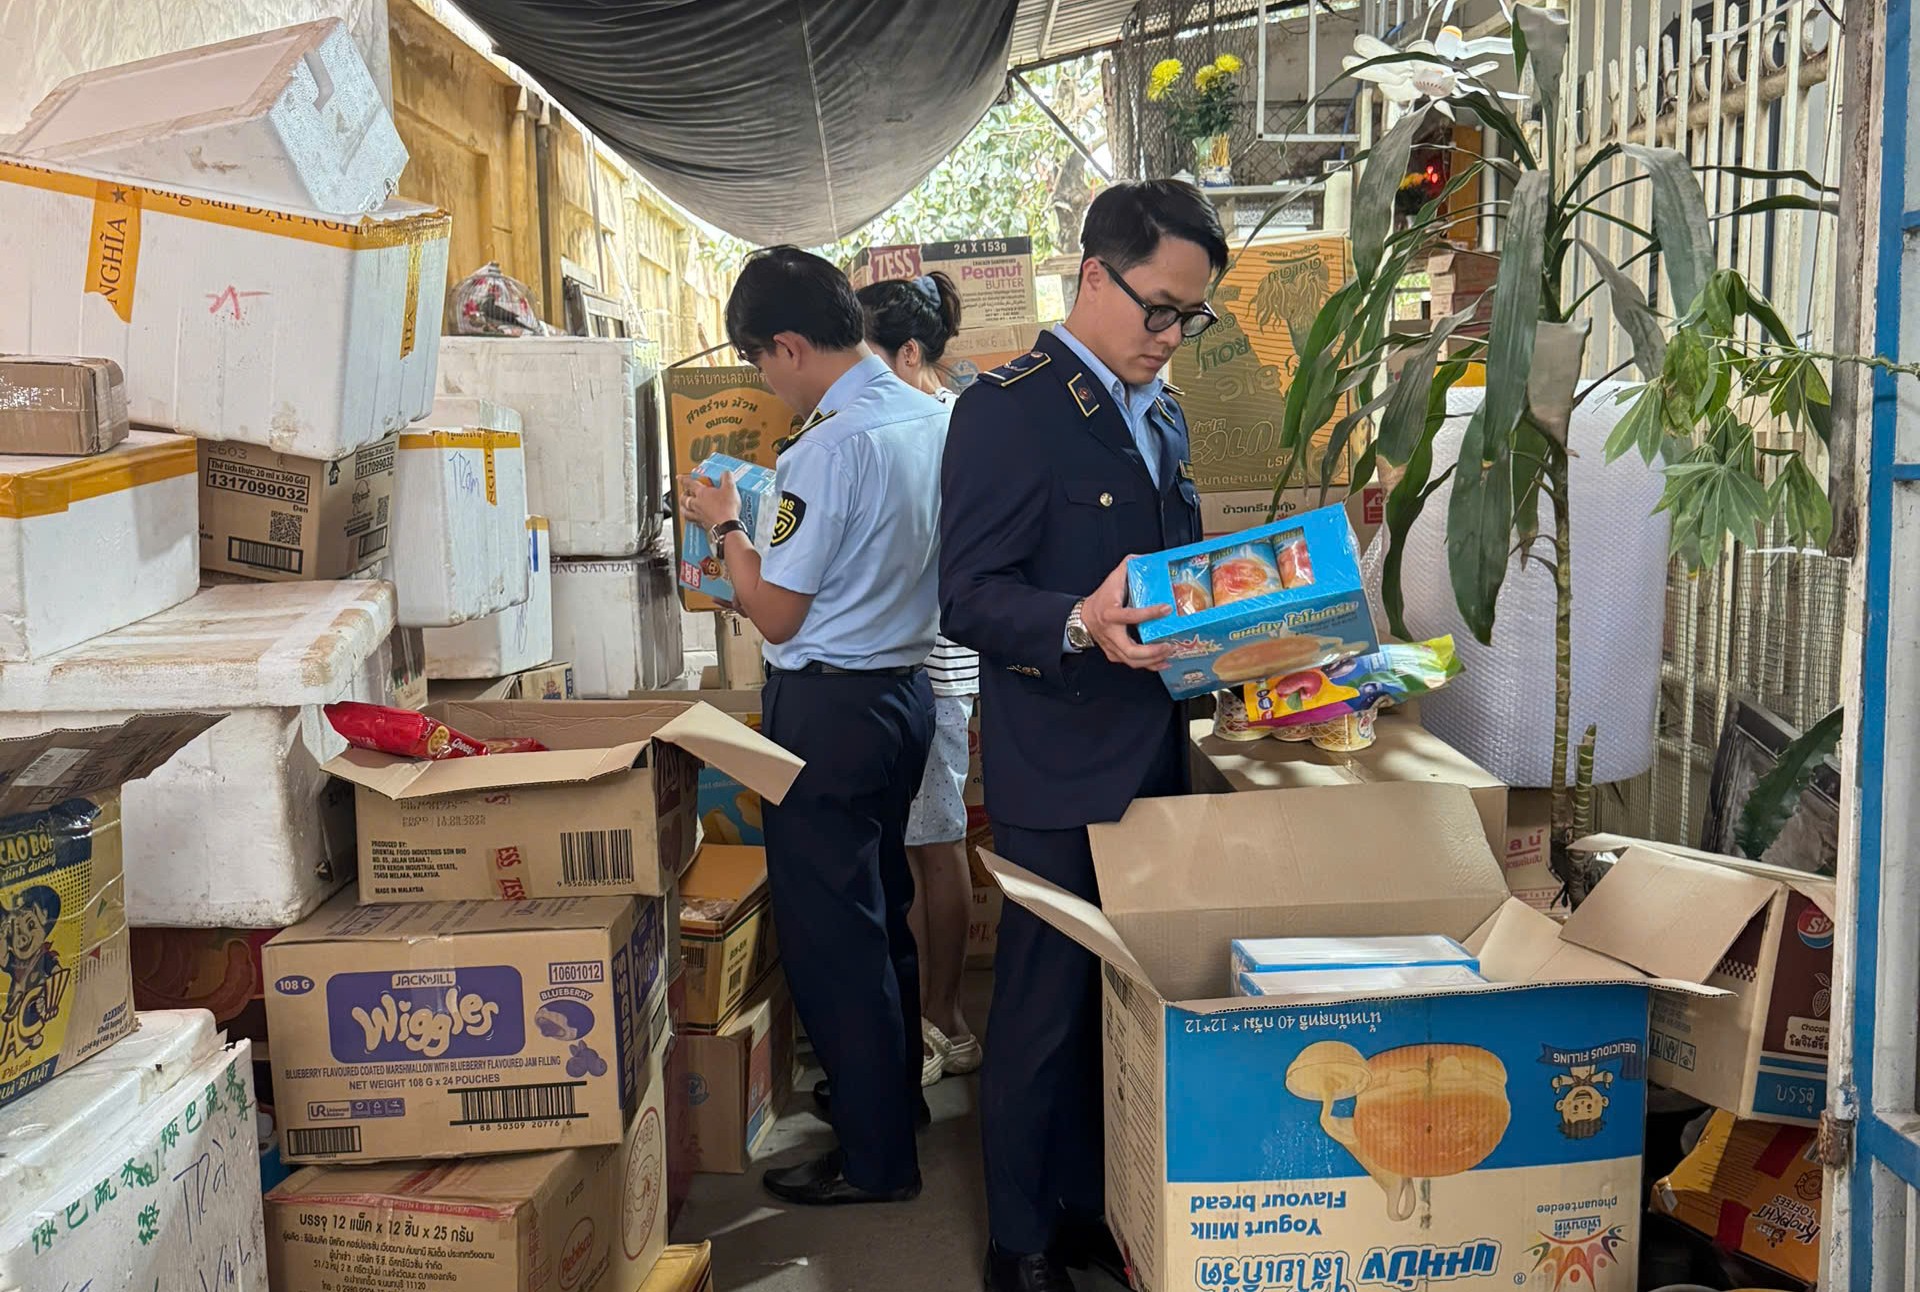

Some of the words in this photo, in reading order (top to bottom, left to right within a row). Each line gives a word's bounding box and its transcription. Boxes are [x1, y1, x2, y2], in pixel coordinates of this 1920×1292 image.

[953, 243, 967, 254] 24
[981, 241, 1007, 254] 153g
[874, 248, 915, 281] ZESS
[961, 263, 1024, 281] Peanut
[985, 278, 1024, 290] BUTTER
[1215, 365, 1281, 402] BIG
[256, 468, 265, 478] 20
[209, 473, 306, 502] 1317099032
[398, 886, 424, 894] MALAYSIA
[552, 965, 600, 980] 10601012
[279, 979, 299, 991] 108
[301, 979, 310, 990] G
[540, 987, 593, 1001] BLUEBERRY
[352, 987, 499, 1057] Wiggles
[1244, 1015, 1274, 1034] กรัม
[1278, 1015, 1296, 1031] 40
[1300, 1010, 1382, 1032] น้ำหนักสุทธิ
[1553, 1048, 1589, 1064] FILLING
[1592, 1043, 1637, 1060] DELICIOUS
[285, 1068, 322, 1080] BLUEBERRY
[323, 1066, 359, 1078] FLAVOURED
[360, 1065, 385, 1076] COATED
[386, 1062, 433, 1075] MARSHMALLOW
[434, 1061, 449, 1072] WITH
[450, 1059, 486, 1072] BLUEBERRY
[487, 1057, 524, 1069] FLAVOURED
[524, 1057, 537, 1067] JAM
[538, 1055, 561, 1066] FILLING
[350, 1081, 368, 1090] NET
[369, 1079, 407, 1089] WEIGHT
[409, 1078, 424, 1088] 108
[425, 1077, 433, 1087] G
[443, 1076, 453, 1086] 24
[456, 1074, 500, 1085] POUCHES
[1776, 1084, 1815, 1114] บรรจุ
[1191, 1194, 1257, 1214] bread
[1262, 1190, 1347, 1212] Flavour
[1537, 1194, 1618, 1216] phouanteedee
[1773, 1194, 1816, 1219] TOFFEES
[299, 1212, 327, 1233] บรรจุ
[332, 1215, 346, 1230] 12
[350, 1211, 372, 1232] แพ็ค
[376, 1221, 383, 1233] x
[389, 1219, 401, 1236] 12
[405, 1214, 419, 1238] ชิ้น
[422, 1227, 429, 1239] x
[433, 1225, 447, 1241] 25
[451, 1225, 475, 1243] กรัม
[1191, 1218, 1239, 1239] Milk
[1245, 1214, 1322, 1238] Yogurt
[1360, 1243, 1496, 1291] ขนมปัง
